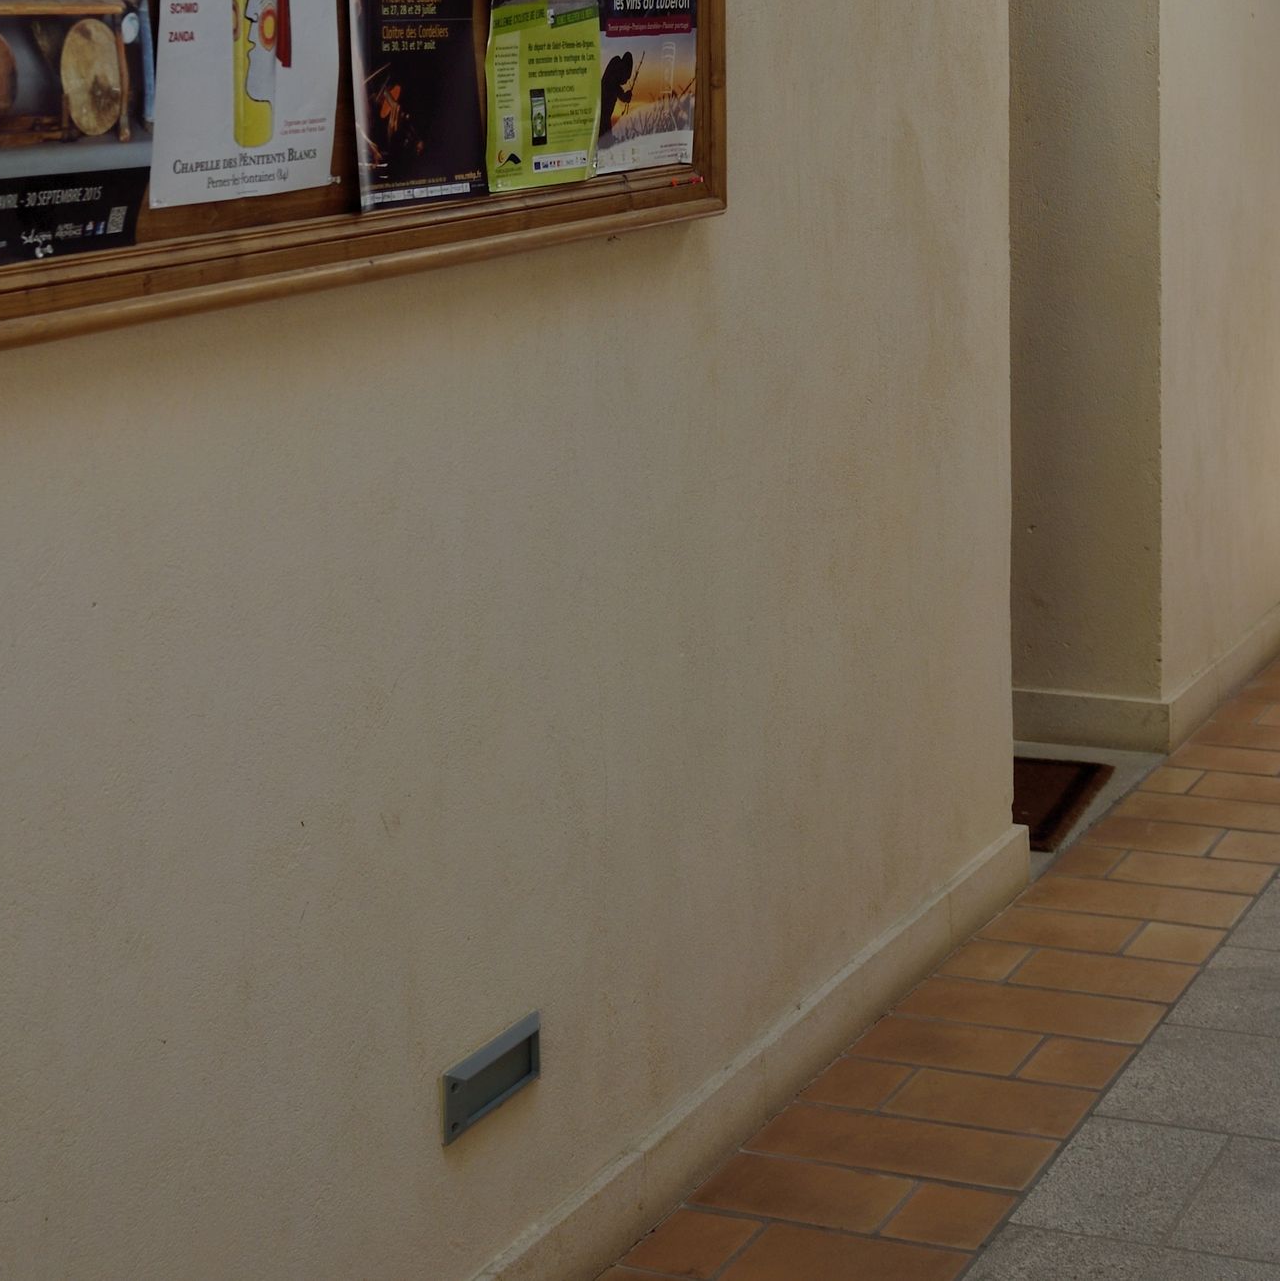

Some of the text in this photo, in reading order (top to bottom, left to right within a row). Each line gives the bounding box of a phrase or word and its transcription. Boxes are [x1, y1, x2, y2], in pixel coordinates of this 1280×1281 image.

[170, 3, 198, 14] SCHMID
[168, 31, 194, 42] ZANDA
[382, 24, 449, 39] Cloître des Cordeliers
[173, 148, 317, 175] CHAPELLE DES PÉNITENTS BLANCS
[25, 192, 36, 207] 30
[37, 188, 82, 207] SEPTEMBRE
[83, 185, 103, 202] 2015
